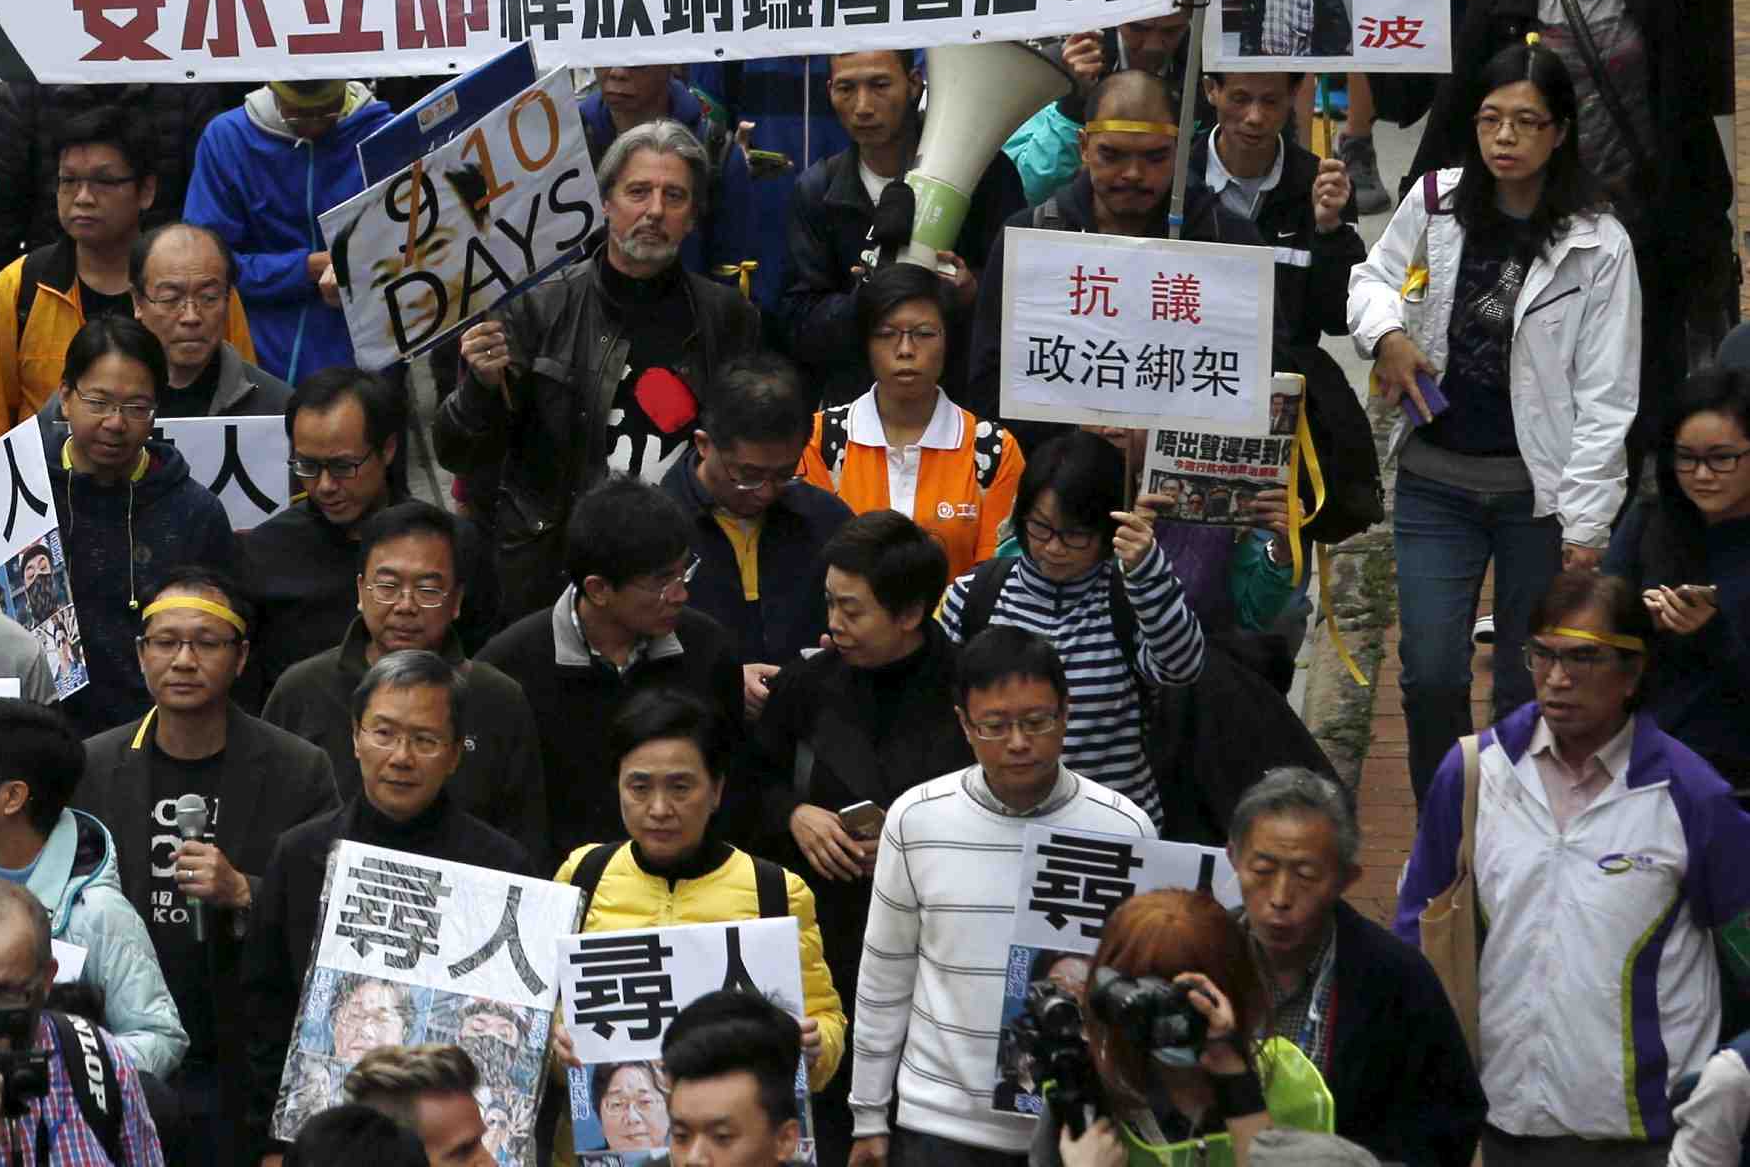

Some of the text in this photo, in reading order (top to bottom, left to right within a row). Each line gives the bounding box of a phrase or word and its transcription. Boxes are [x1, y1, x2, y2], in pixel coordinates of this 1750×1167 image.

[383, 168, 595, 354] DAYS
[1069, 264, 1202, 325] 抗議
[1025, 335, 1241, 397] 政治綁架
[335, 855, 548, 997] 尋人
